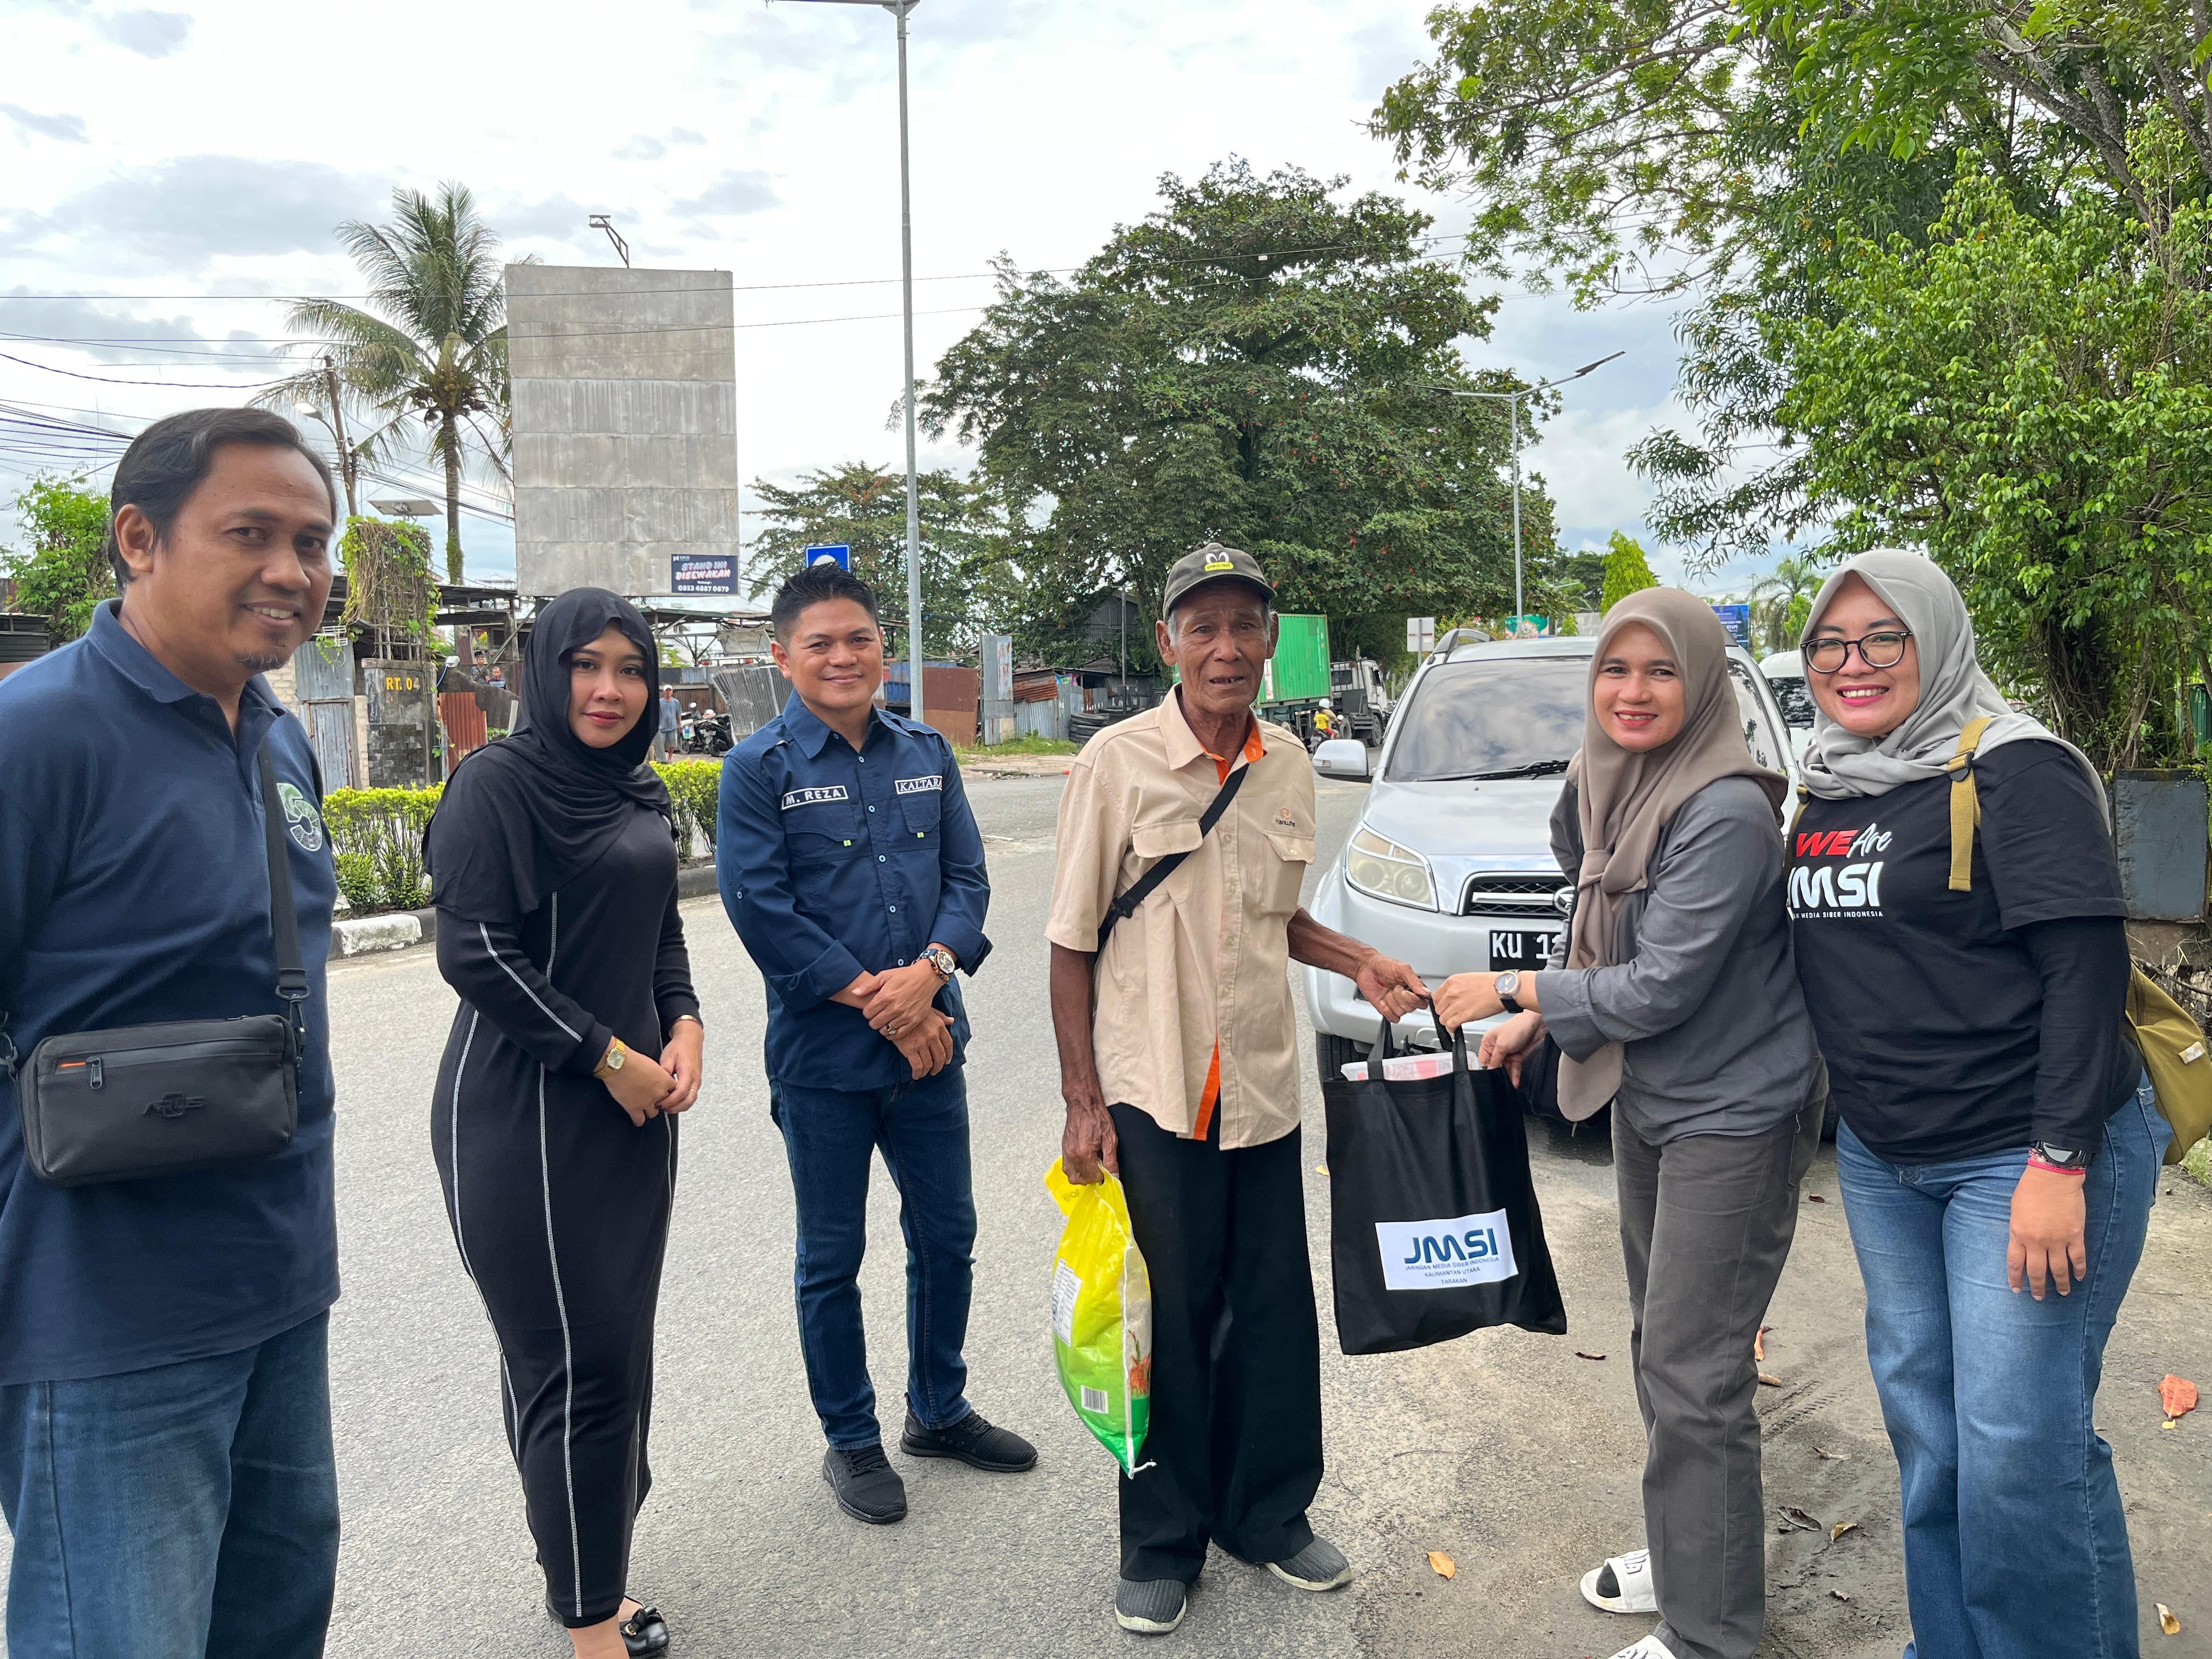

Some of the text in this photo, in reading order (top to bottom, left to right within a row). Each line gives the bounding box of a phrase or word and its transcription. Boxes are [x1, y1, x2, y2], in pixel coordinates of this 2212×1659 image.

[681, 560, 728, 571] STAND INI
[675, 569, 731, 580] DISEWAKAN
[386, 677, 403, 690] RT.
[786, 789, 842, 805] M. REZA
[1796, 823, 1892, 858] WE Are
[1492, 933, 1562, 959] KU 1
[1404, 1228, 1498, 1264] JMSI
[1470, 1256, 1499, 1265] INDONESIA
[1462, 1266, 1480, 1274] UTARA
